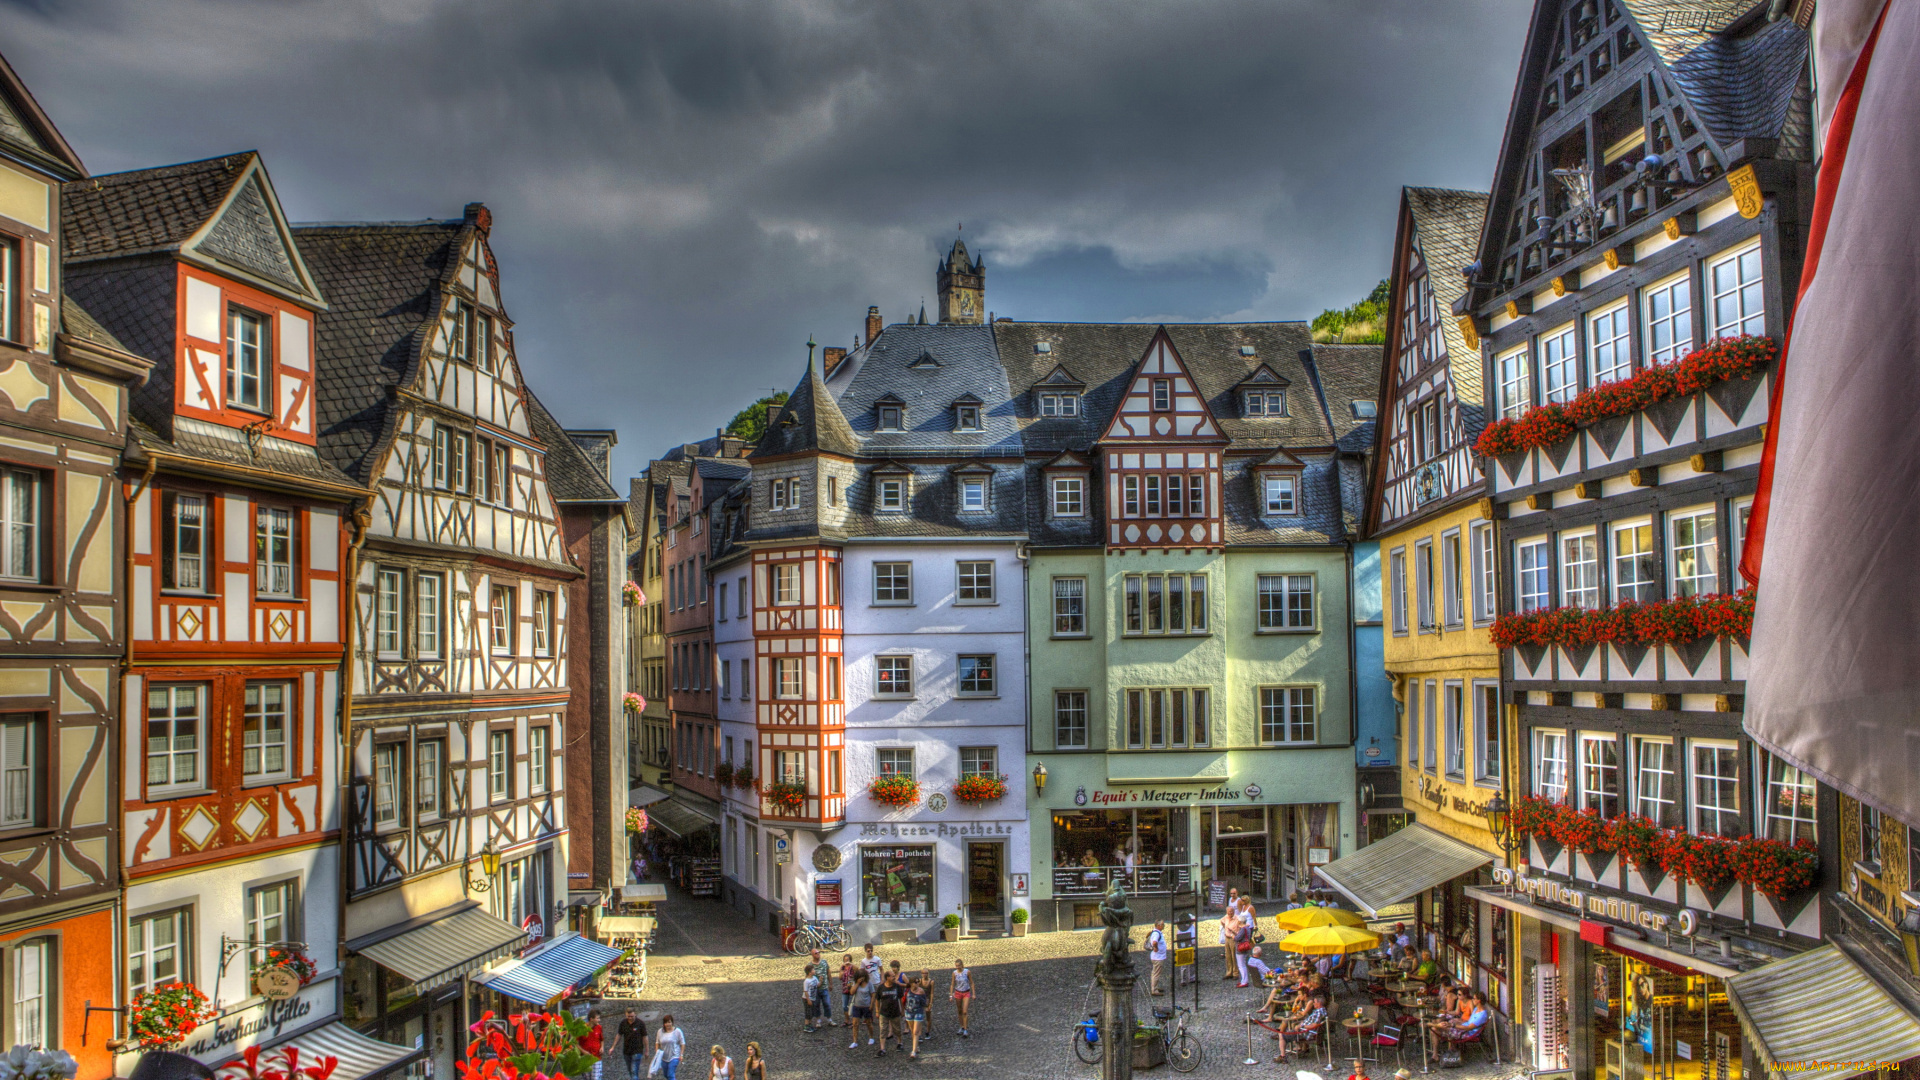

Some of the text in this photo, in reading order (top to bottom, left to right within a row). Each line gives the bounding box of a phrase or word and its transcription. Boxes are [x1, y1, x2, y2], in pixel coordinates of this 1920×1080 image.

[1141, 788, 1241, 803] Metzger-Imbiss
[860, 822, 1013, 838] Mohren-Apotheke
[1516, 873, 1671, 932] brillen müller
[268, 988, 289, 997] Gilles
[270, 997, 311, 1037] Gilles
